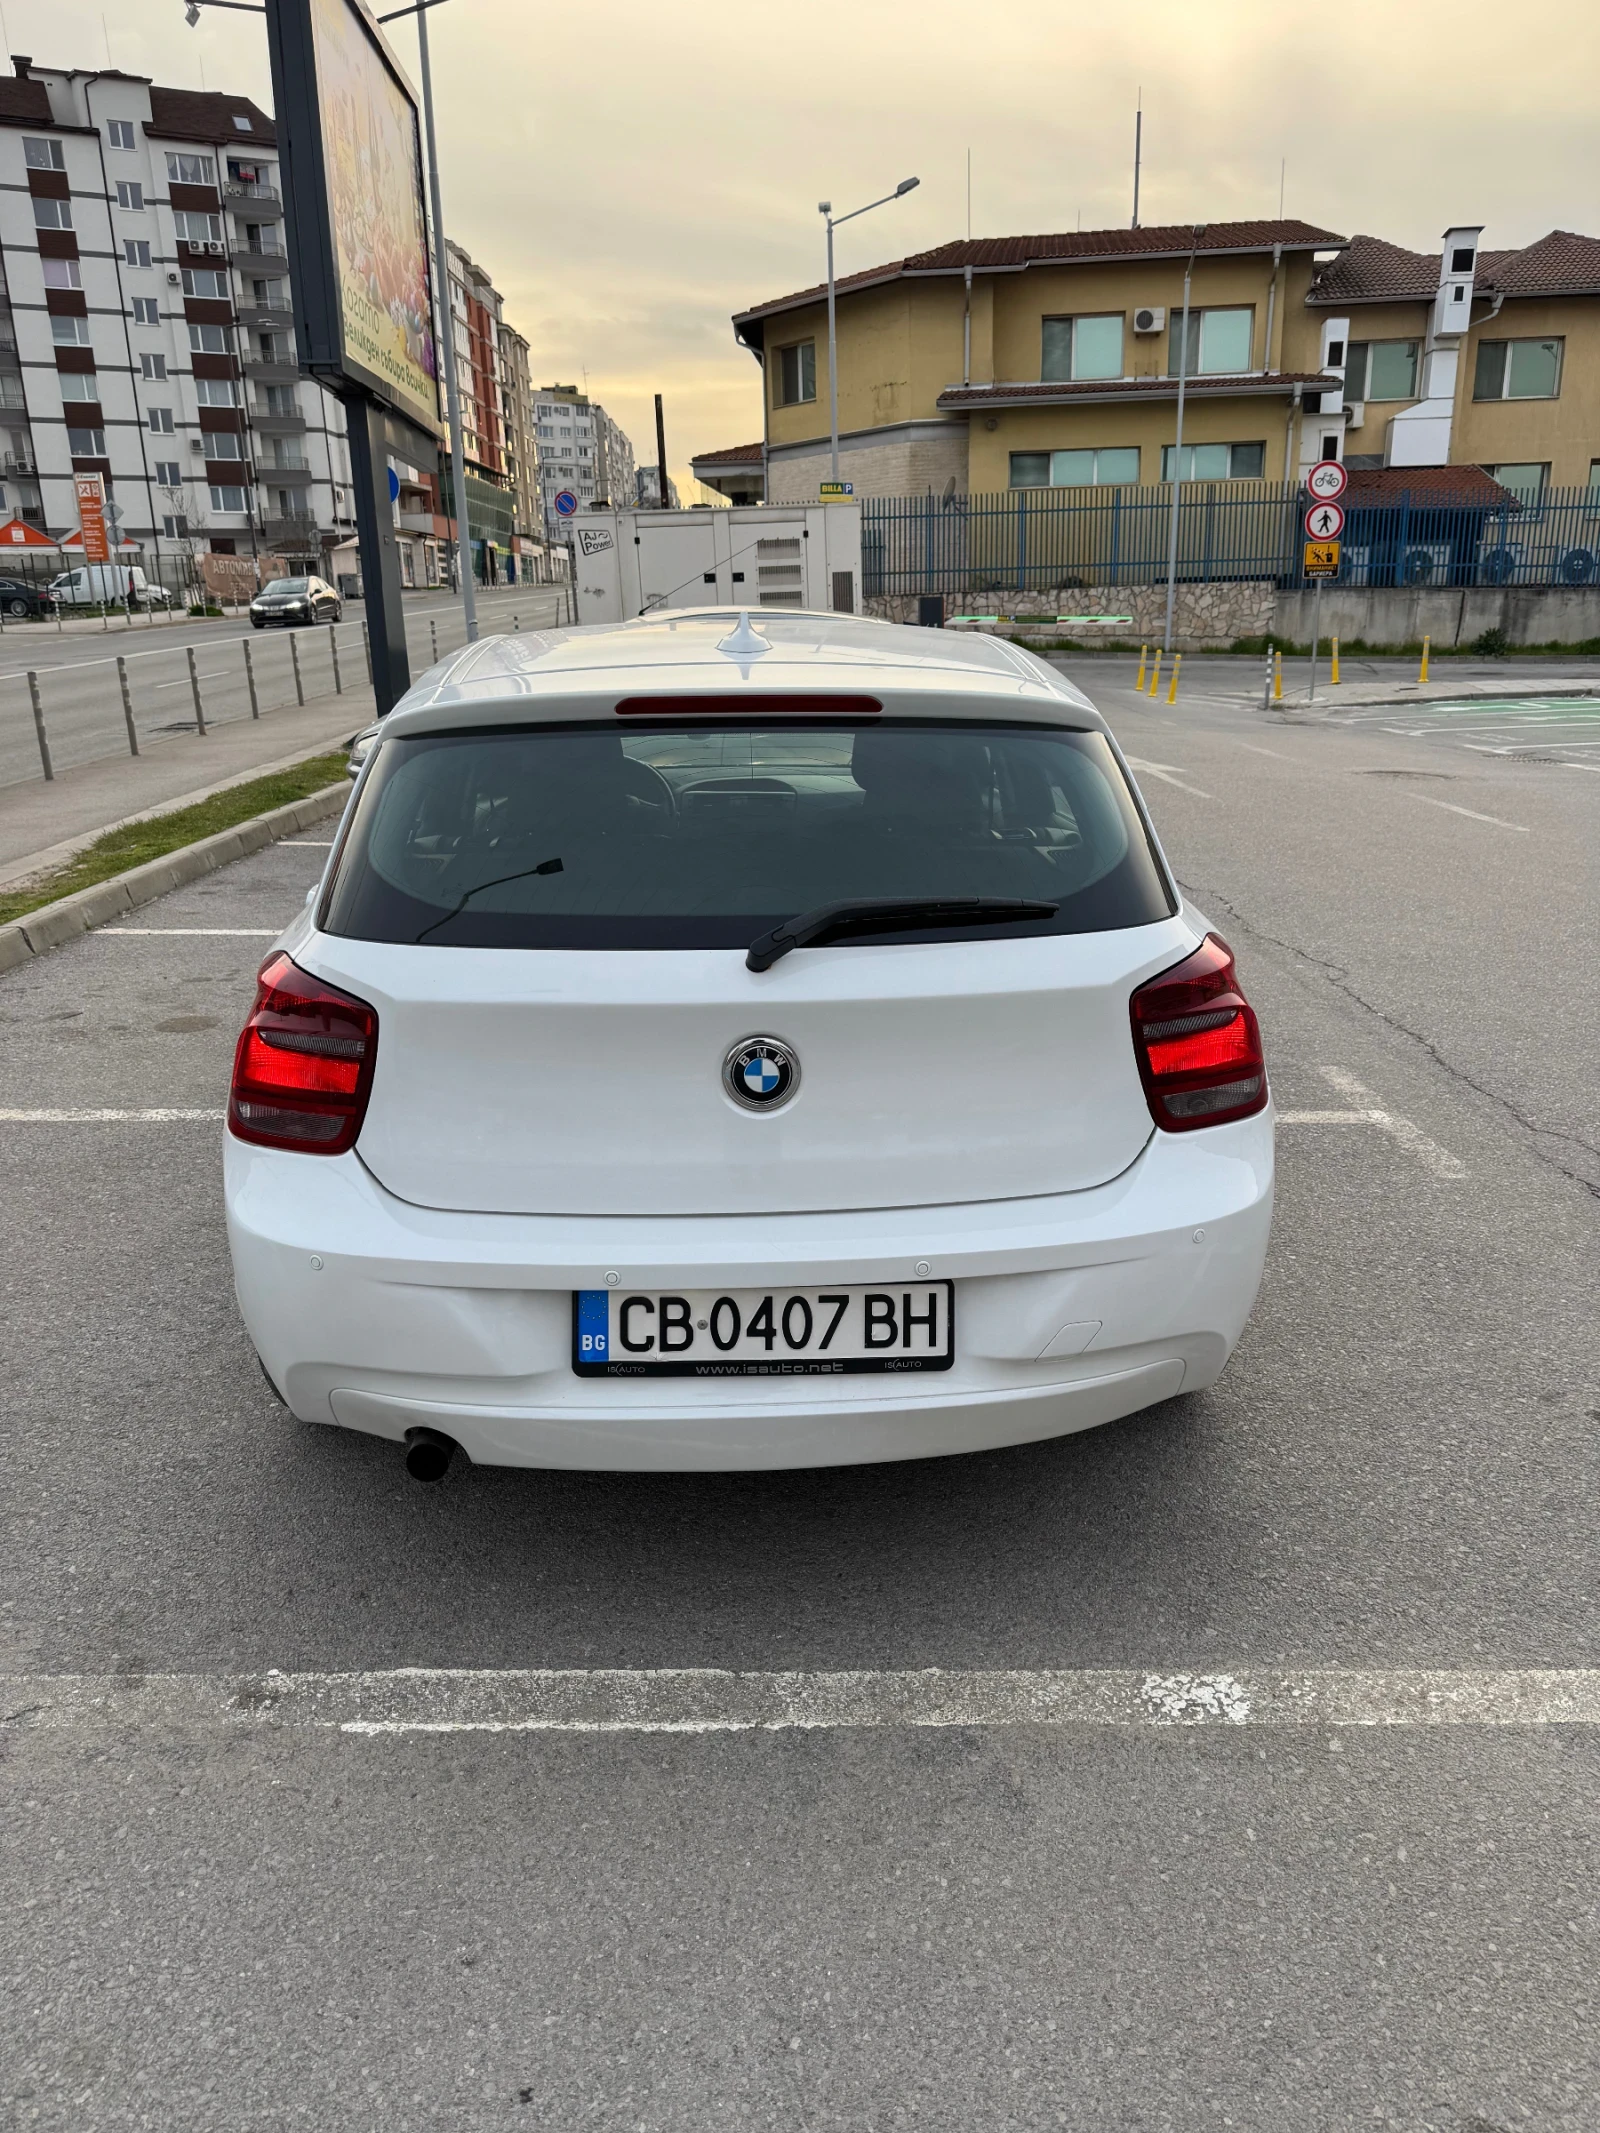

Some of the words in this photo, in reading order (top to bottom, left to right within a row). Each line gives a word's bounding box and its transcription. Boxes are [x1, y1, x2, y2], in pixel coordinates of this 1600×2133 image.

[821, 484, 842, 493] BILLA
[584, 532, 597, 542] AJ
[585, 540, 611, 552] Power
[739, 1048, 786, 1067] BMW
[710, 1295, 849, 1351] 0407
[582, 1335, 605, 1350] BG
[696, 1362, 843, 1375] www.isauto.net
